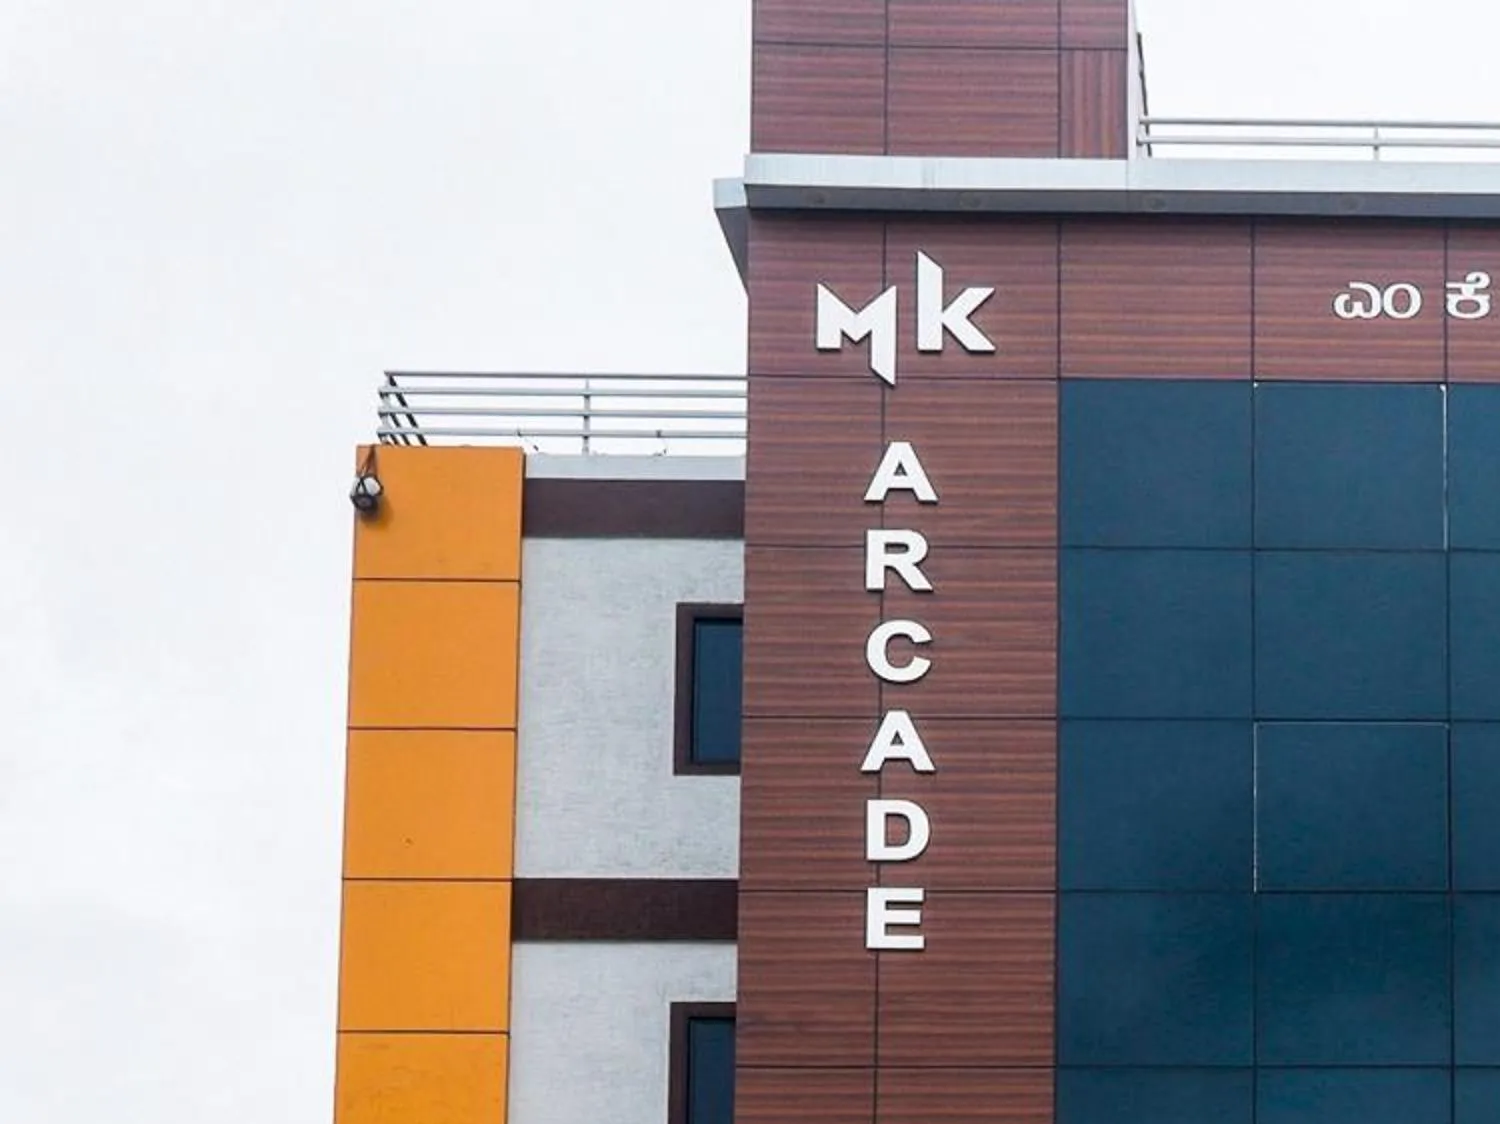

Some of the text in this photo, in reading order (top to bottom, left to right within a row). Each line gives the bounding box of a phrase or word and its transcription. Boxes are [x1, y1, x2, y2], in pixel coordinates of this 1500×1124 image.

[1333, 281, 1422, 320] ಎಂ
[1445, 270, 1491, 320] ಕೆ
[861, 440, 938, 950] ARCADE
